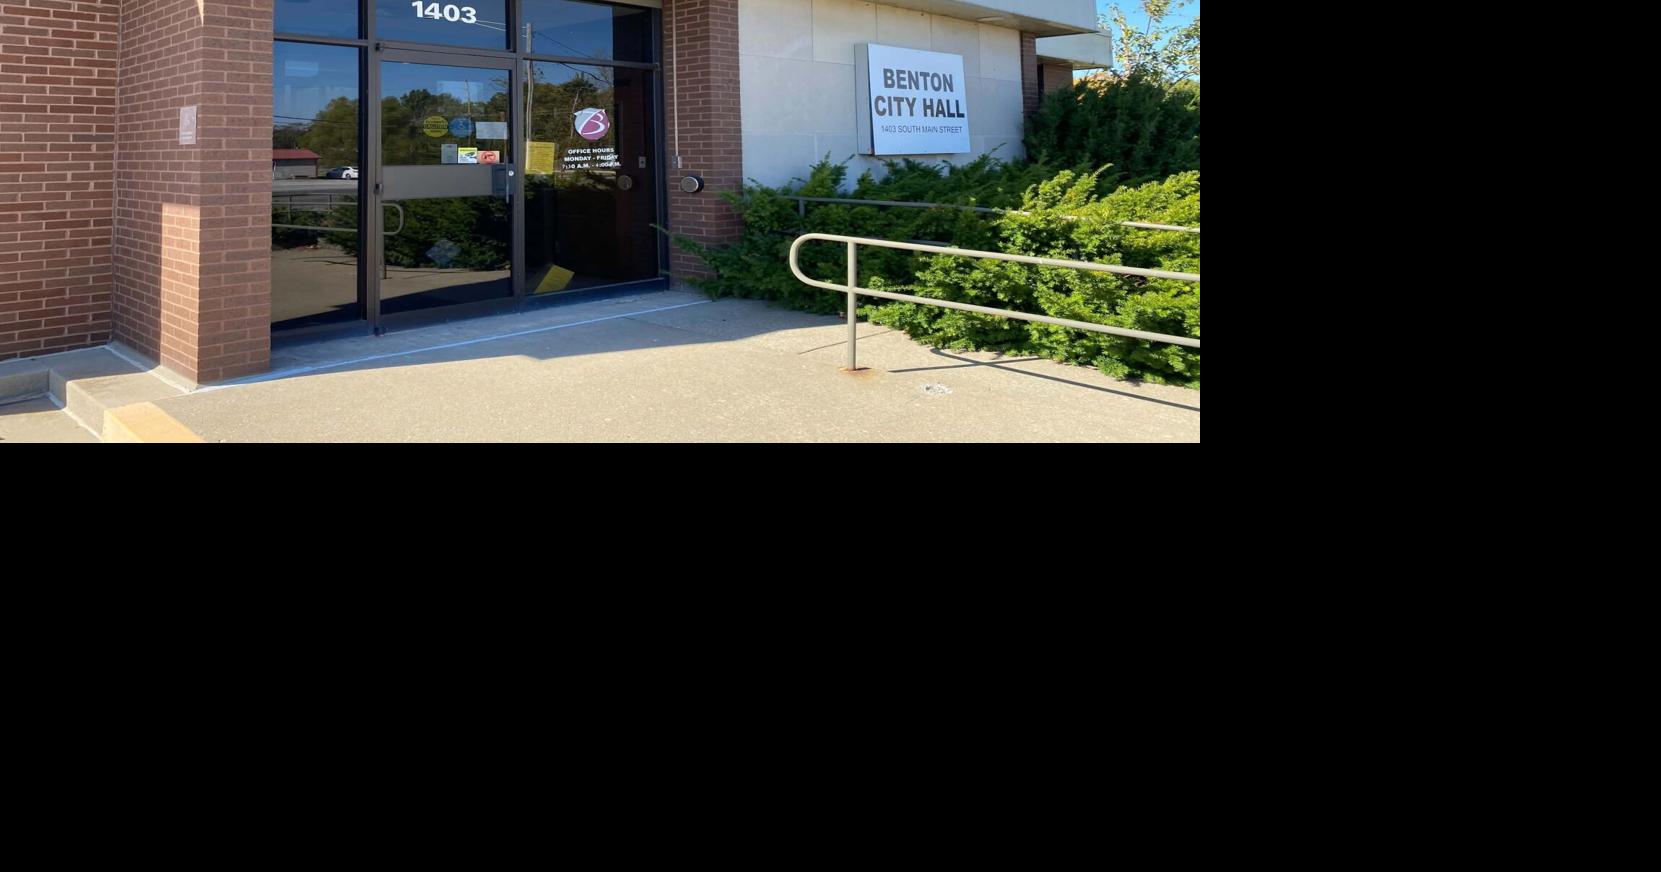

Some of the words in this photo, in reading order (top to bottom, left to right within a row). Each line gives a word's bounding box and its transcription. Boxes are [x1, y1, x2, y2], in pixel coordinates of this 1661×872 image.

[411, 0, 477, 24] 1403
[883, 68, 954, 92] BENTON
[874, 95, 917, 117] CITY
[922, 98, 965, 118] HALL
[881, 125, 896, 133] 1403
[897, 125, 920, 133] SOUTH
